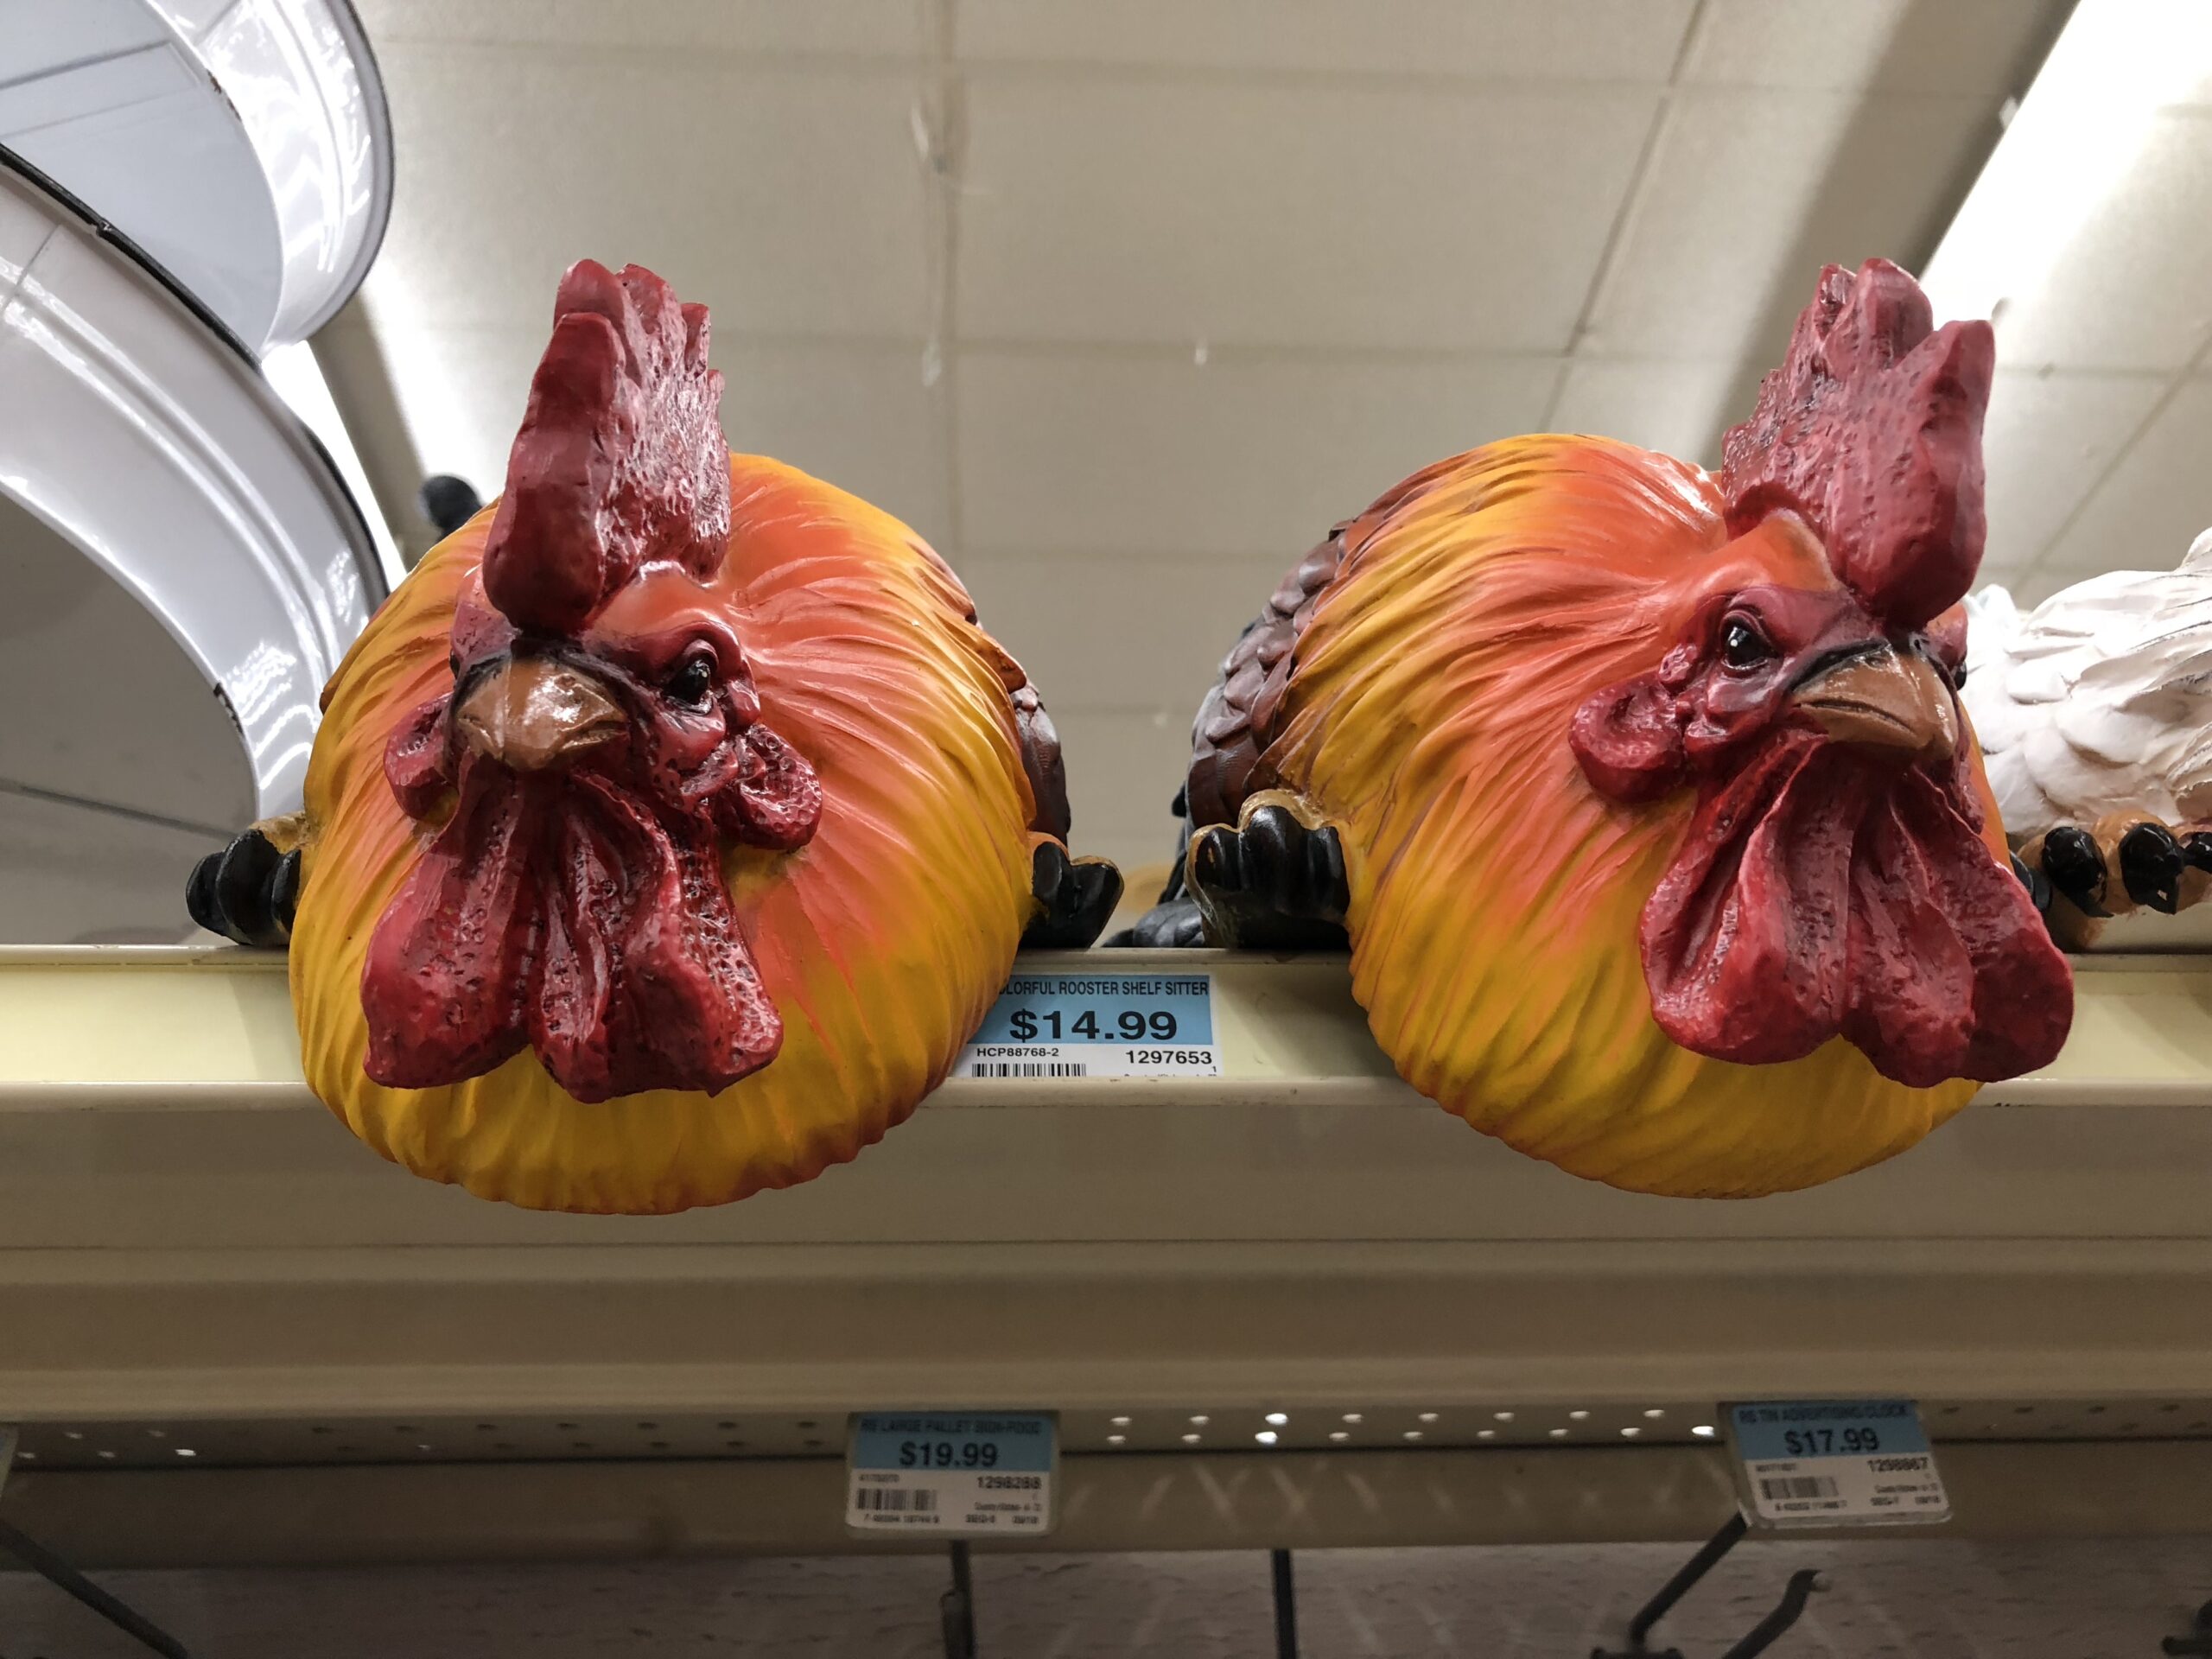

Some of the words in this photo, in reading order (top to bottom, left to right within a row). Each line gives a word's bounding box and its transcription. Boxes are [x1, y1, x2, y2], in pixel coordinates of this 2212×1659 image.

[1060, 981, 1119, 995] ROOSTER
[1122, 981, 1161, 995] SHELF
[1165, 981, 1209, 996] SITTER
[1009, 1008, 1178, 1043] $14.99
[976, 1047, 1059, 1058] HCP88768-2
[1126, 1050, 1212, 1065] 1297653
[881, 1419, 920, 1433] LARGE
[925, 1420, 969, 1433] PALLET
[1783, 1427, 1880, 1455] $17.99
[899, 1440, 998, 1467] $19.99
